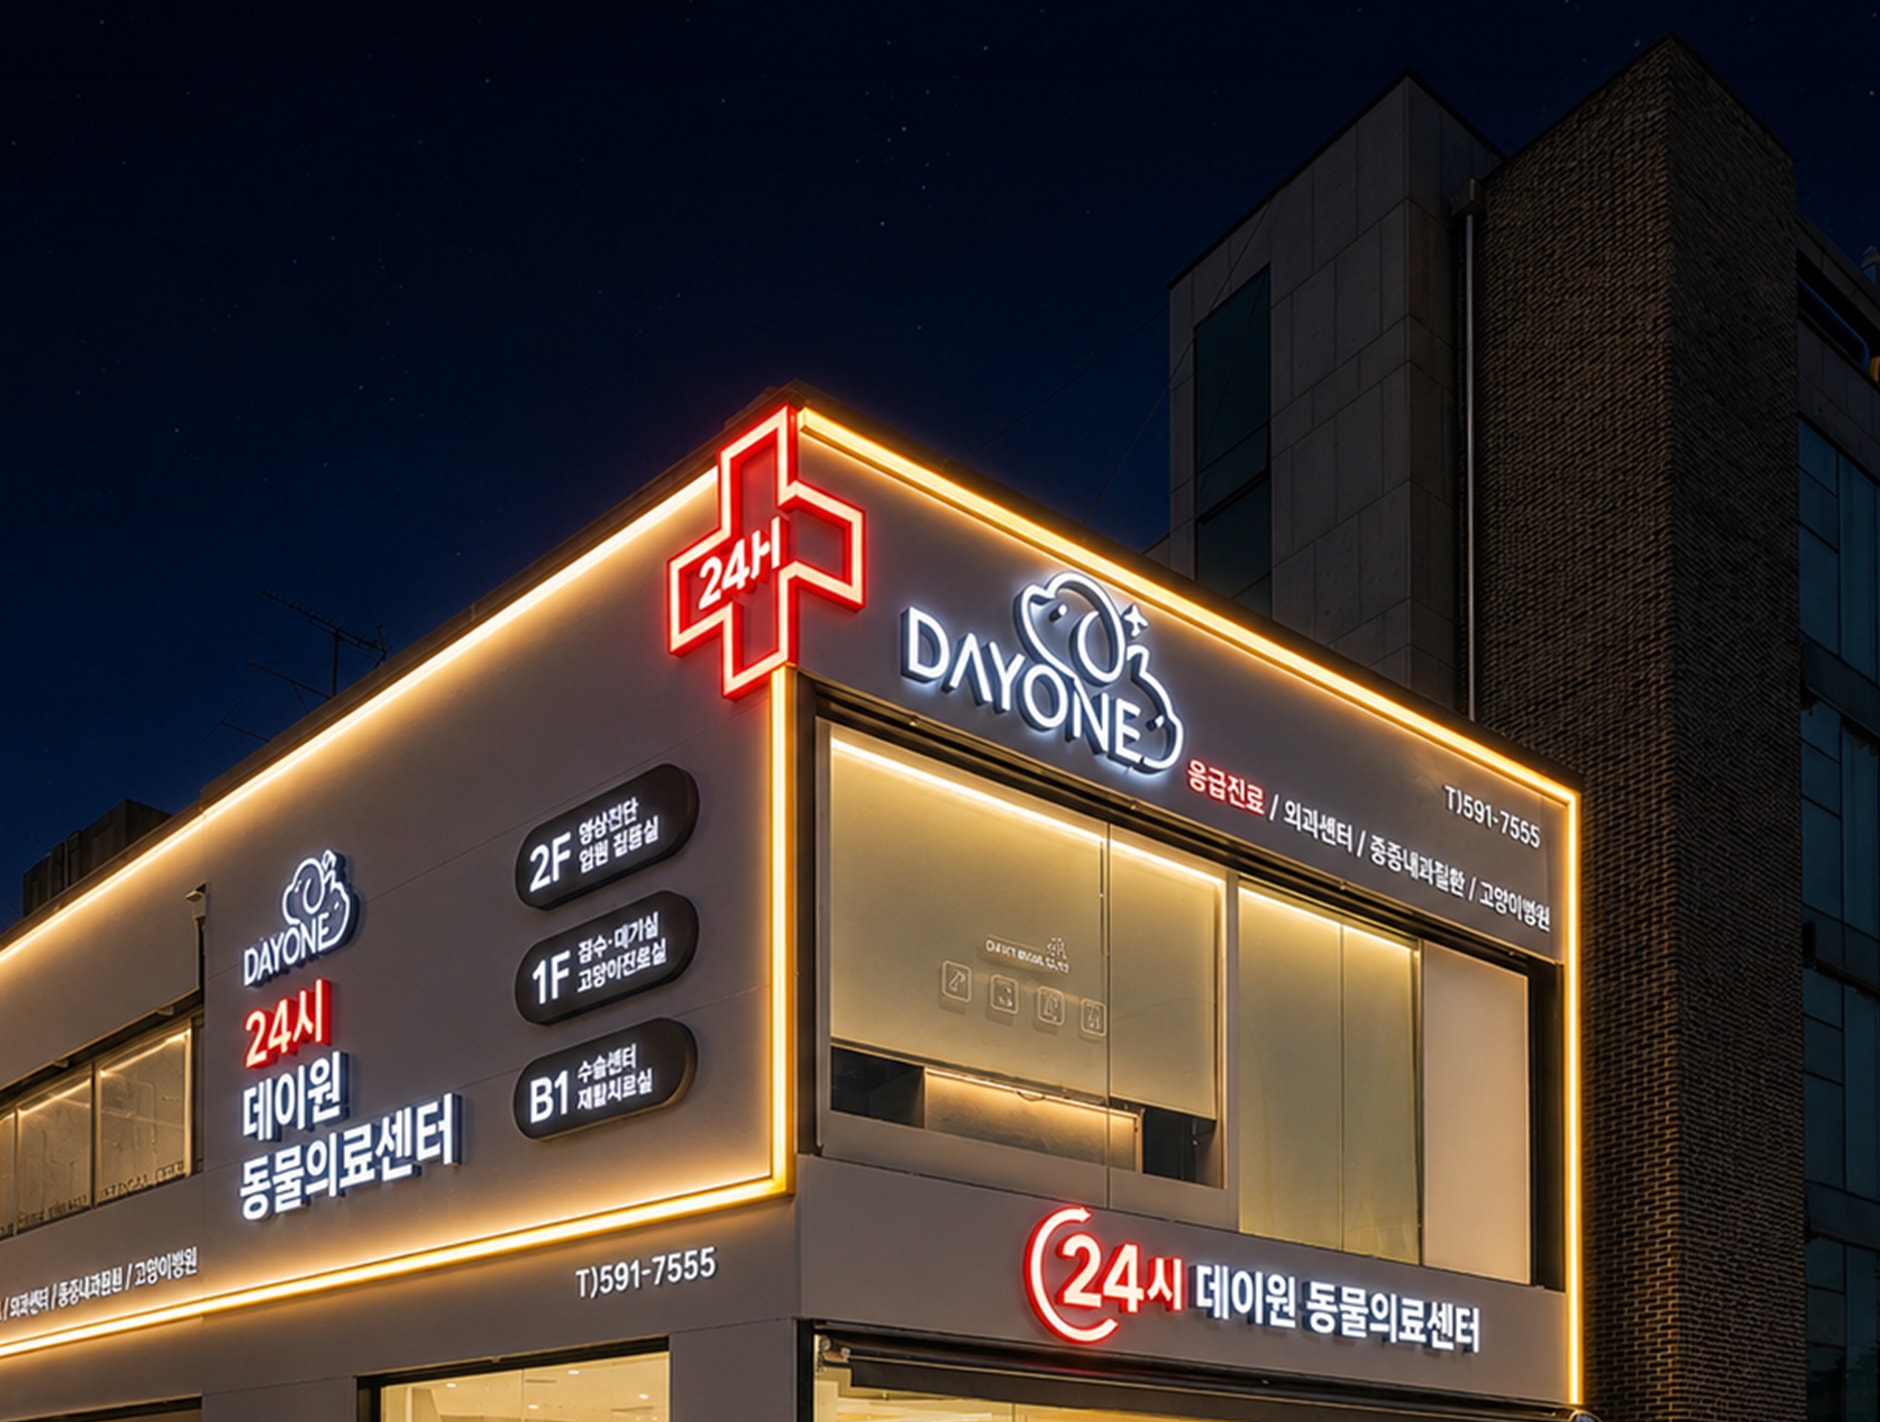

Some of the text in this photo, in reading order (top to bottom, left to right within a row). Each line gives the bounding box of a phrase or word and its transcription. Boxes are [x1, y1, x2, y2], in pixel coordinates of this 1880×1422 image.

[905, 605, 1144, 764] DAYONE
[1188, 759, 1265, 815] 응급진료
[1444, 785, 1541, 848] T)591-7555
[529, 832, 571, 892] 2F
[243, 912, 331, 986] DAYONE
[532, 950, 571, 1004] 1F
[245, 978, 323, 1068] 24시
[243, 1051, 340, 1141] 데이원
[530, 1070, 569, 1124] B1
[240, 1092, 453, 1220] 동물의료센터
[575, 1246, 716, 1299] T)591-7555
[1060, 1234, 1481, 1353] 24시 데이원 동물의료센터
